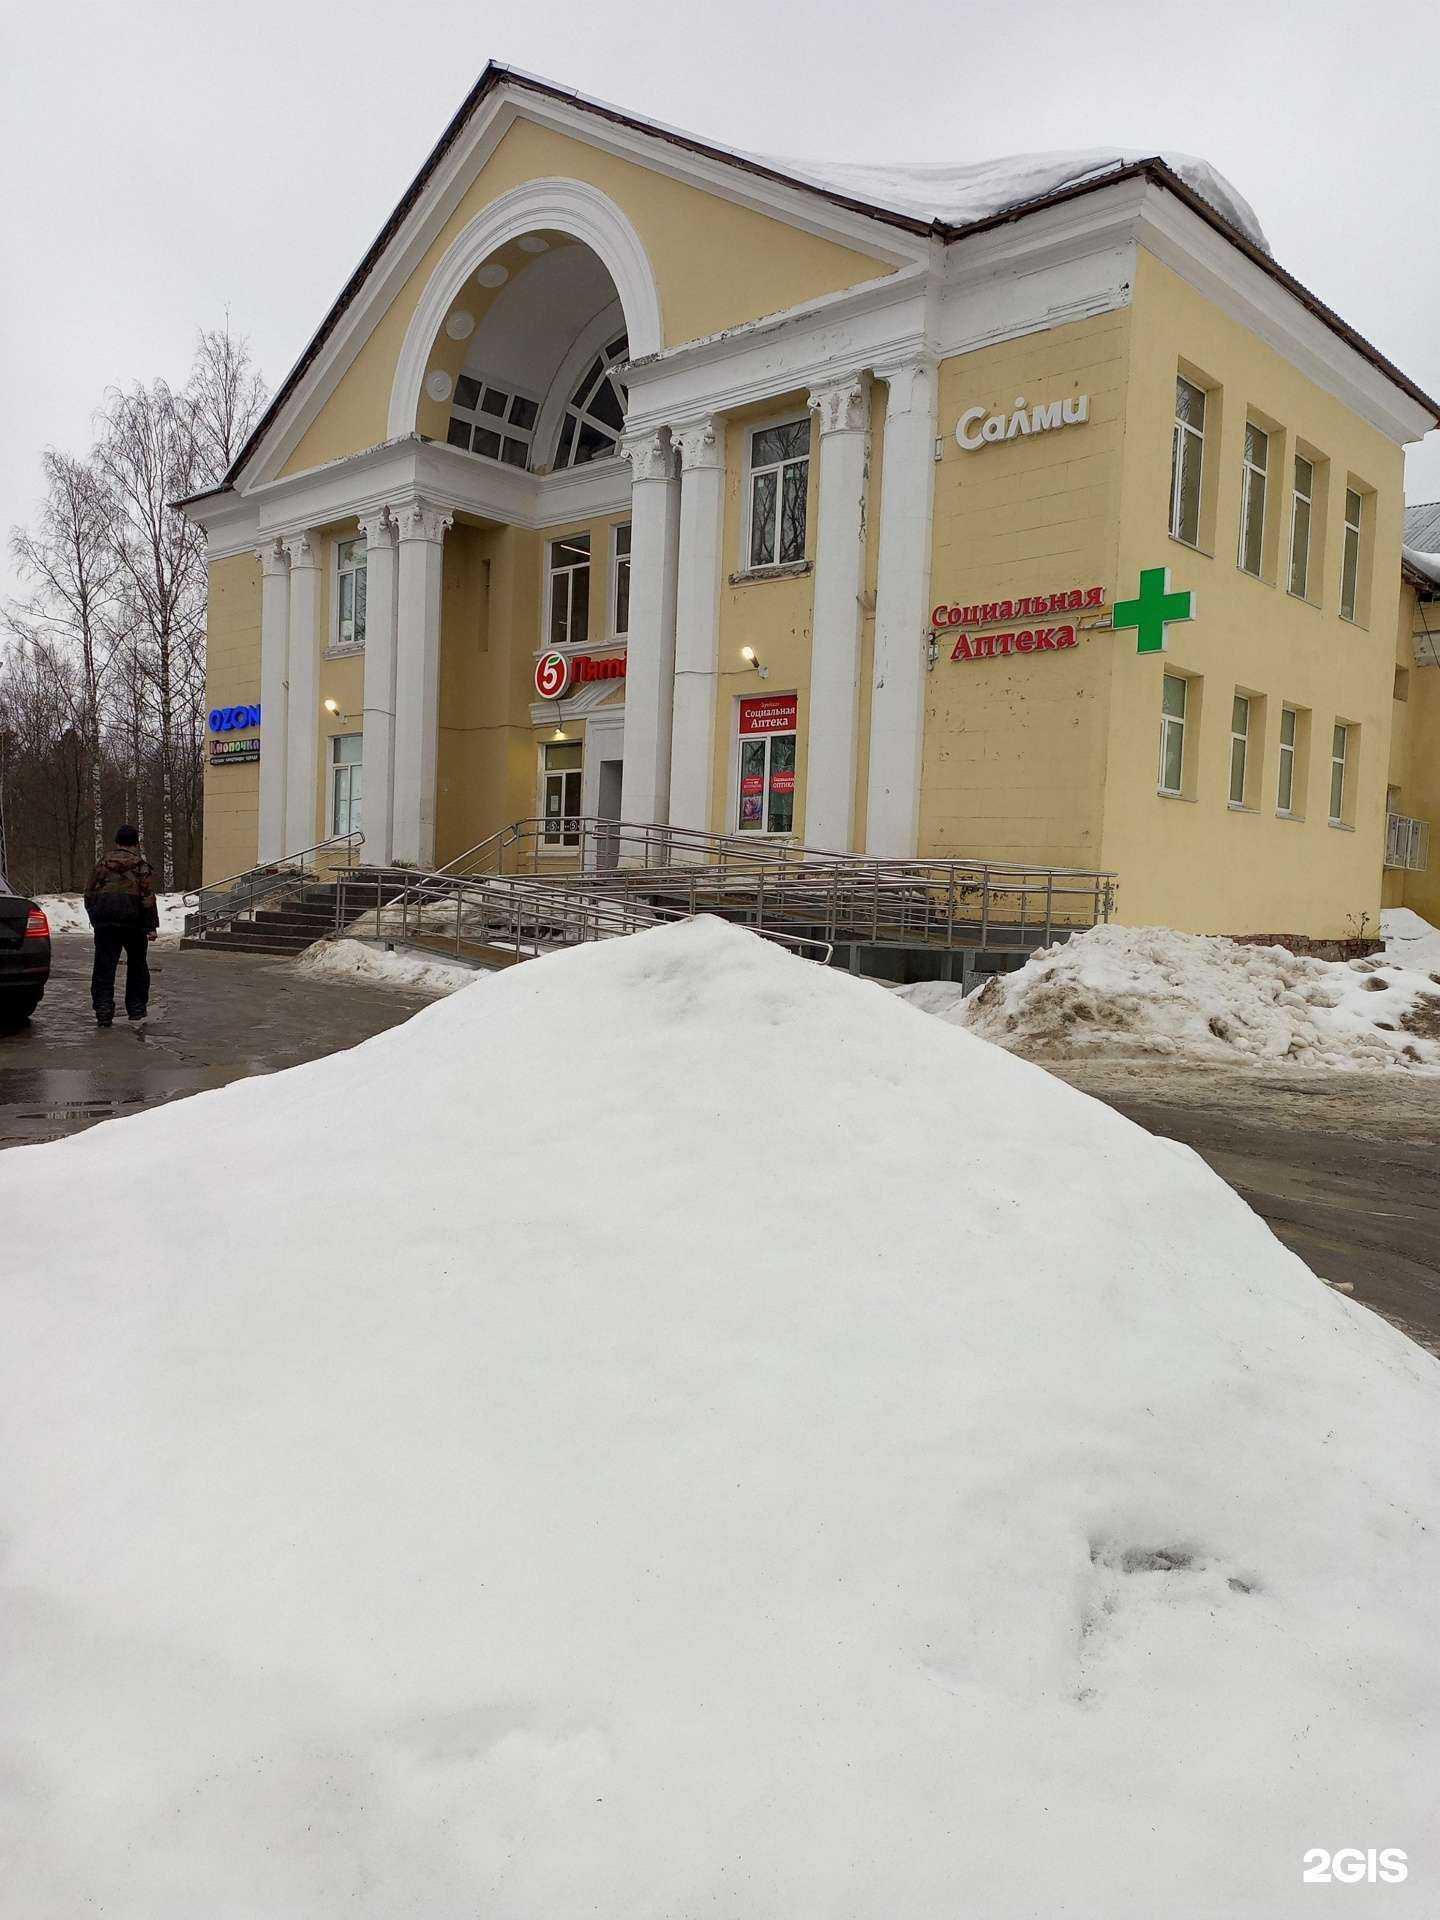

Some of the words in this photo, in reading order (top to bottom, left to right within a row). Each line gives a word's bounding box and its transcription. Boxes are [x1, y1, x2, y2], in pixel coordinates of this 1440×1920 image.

[956, 394, 1089, 451] Салми
[931, 586, 1105, 628] Социальная
[950, 625, 1078, 661] Аптека
[209, 704, 261, 732] OZON
[745, 707, 796, 719] Социальная
[751, 718, 789, 728] Аптека
